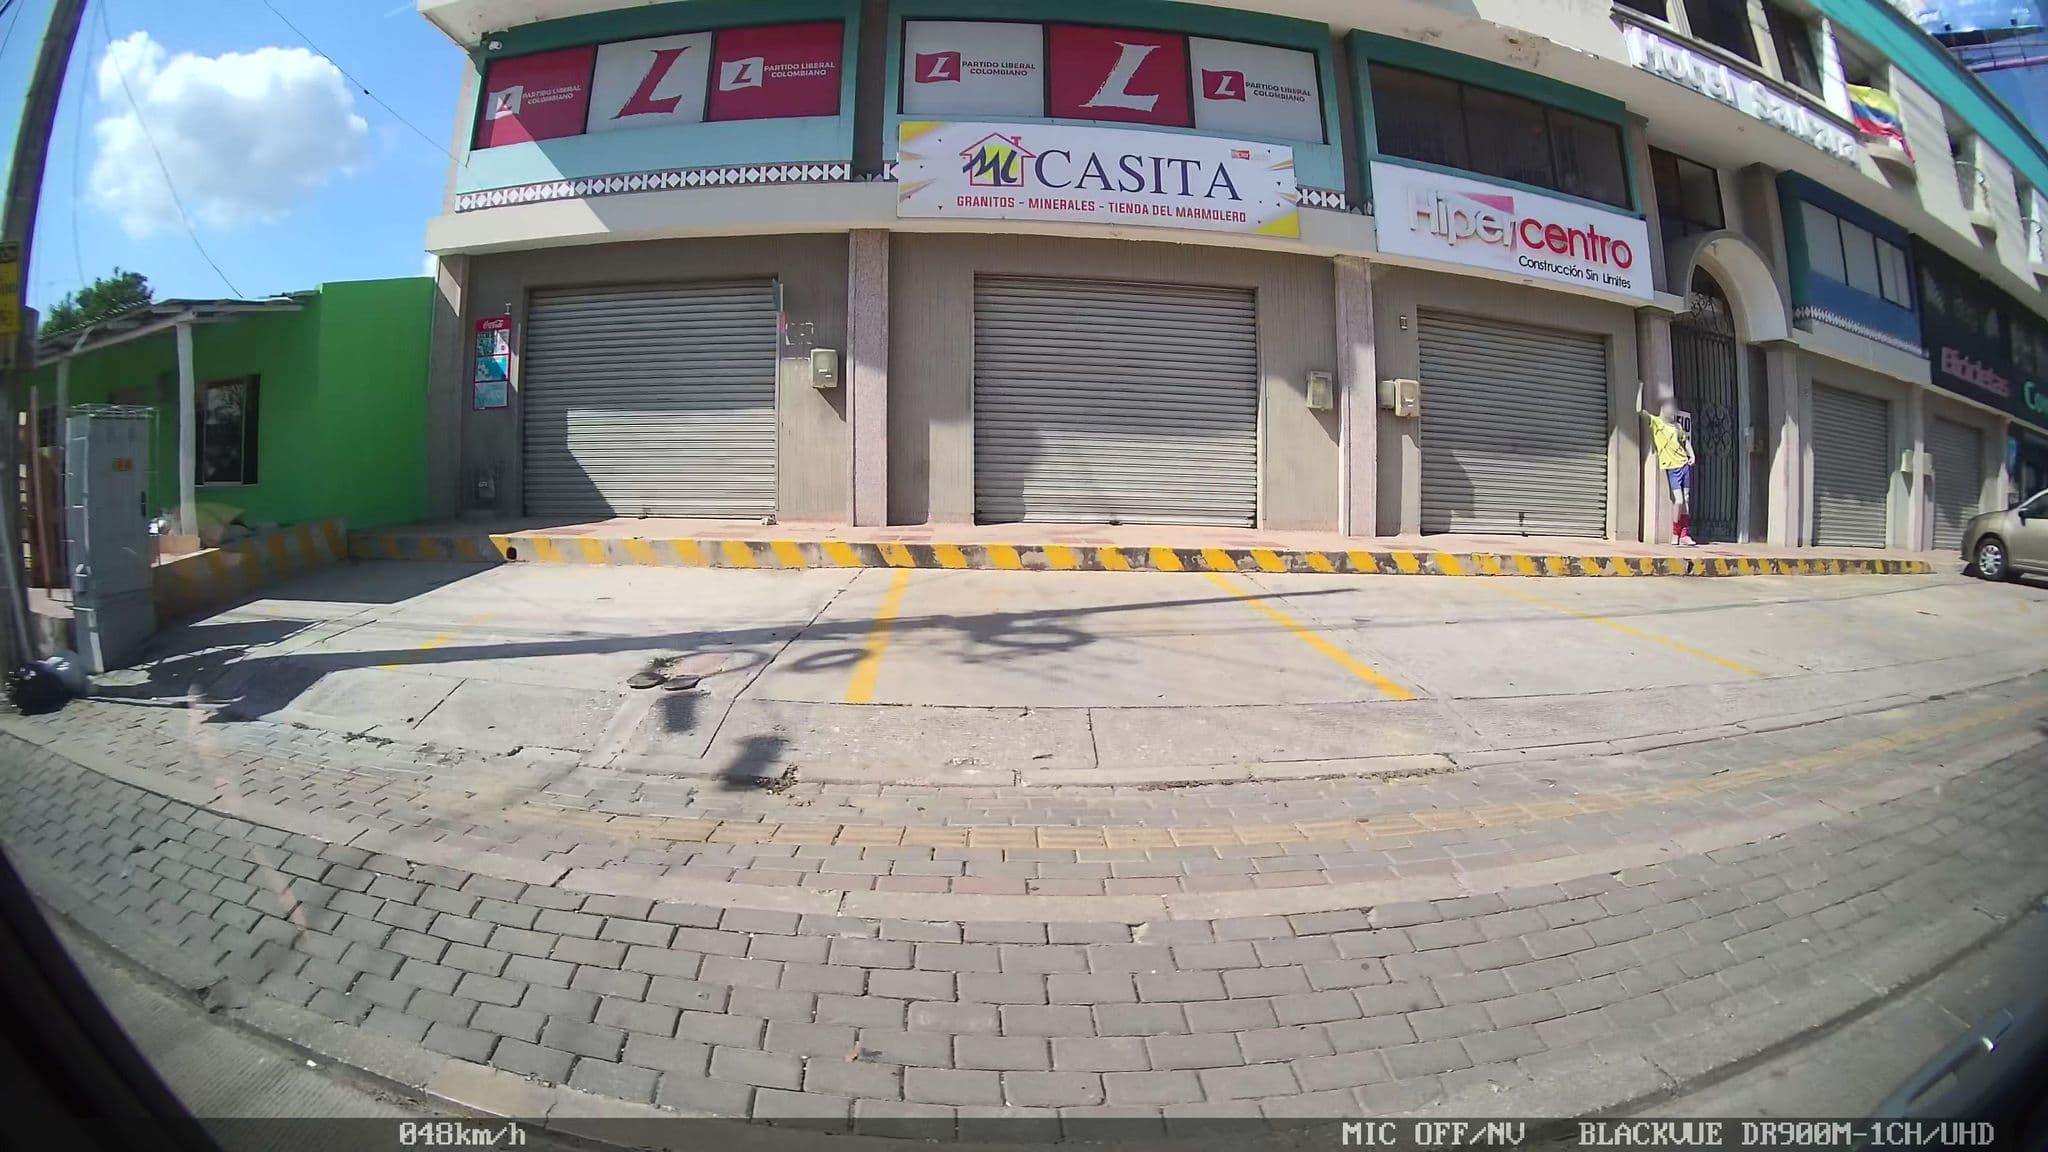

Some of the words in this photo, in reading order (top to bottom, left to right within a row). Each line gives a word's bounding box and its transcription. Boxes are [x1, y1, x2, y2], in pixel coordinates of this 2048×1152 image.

[764, 63, 800, 72] PARTIDO
[801, 61, 836, 70] LIBERAL
[962, 60, 999, 69] PARTIDO
[1001, 62, 1036, 70] LIBERAL
[970, 68, 1028, 77] COLOMBIANO
[771, 69, 827, 78] COLOMBIANO
[1078, 41, 1160, 112] L
[610, 46, 692, 120] L
[1245, 81, 1279, 92] PARTIDO
[1280, 86, 1312, 97] LIBERAL
[1253, 89, 1306, 103] COLOMBIANO
[1034, 149, 1243, 201] CASITA
[957, 195, 1015, 208] GRANITOS
[1028, 198, 1096, 212] MINERALES
[1108, 202, 1149, 215] TIENDA
[1152, 205, 1173, 217] DEL
[1176, 206, 1247, 223] MARMOLERO
[1518, 255, 1583, 280] Construcción
[1586, 268, 1599, 282] Sin
